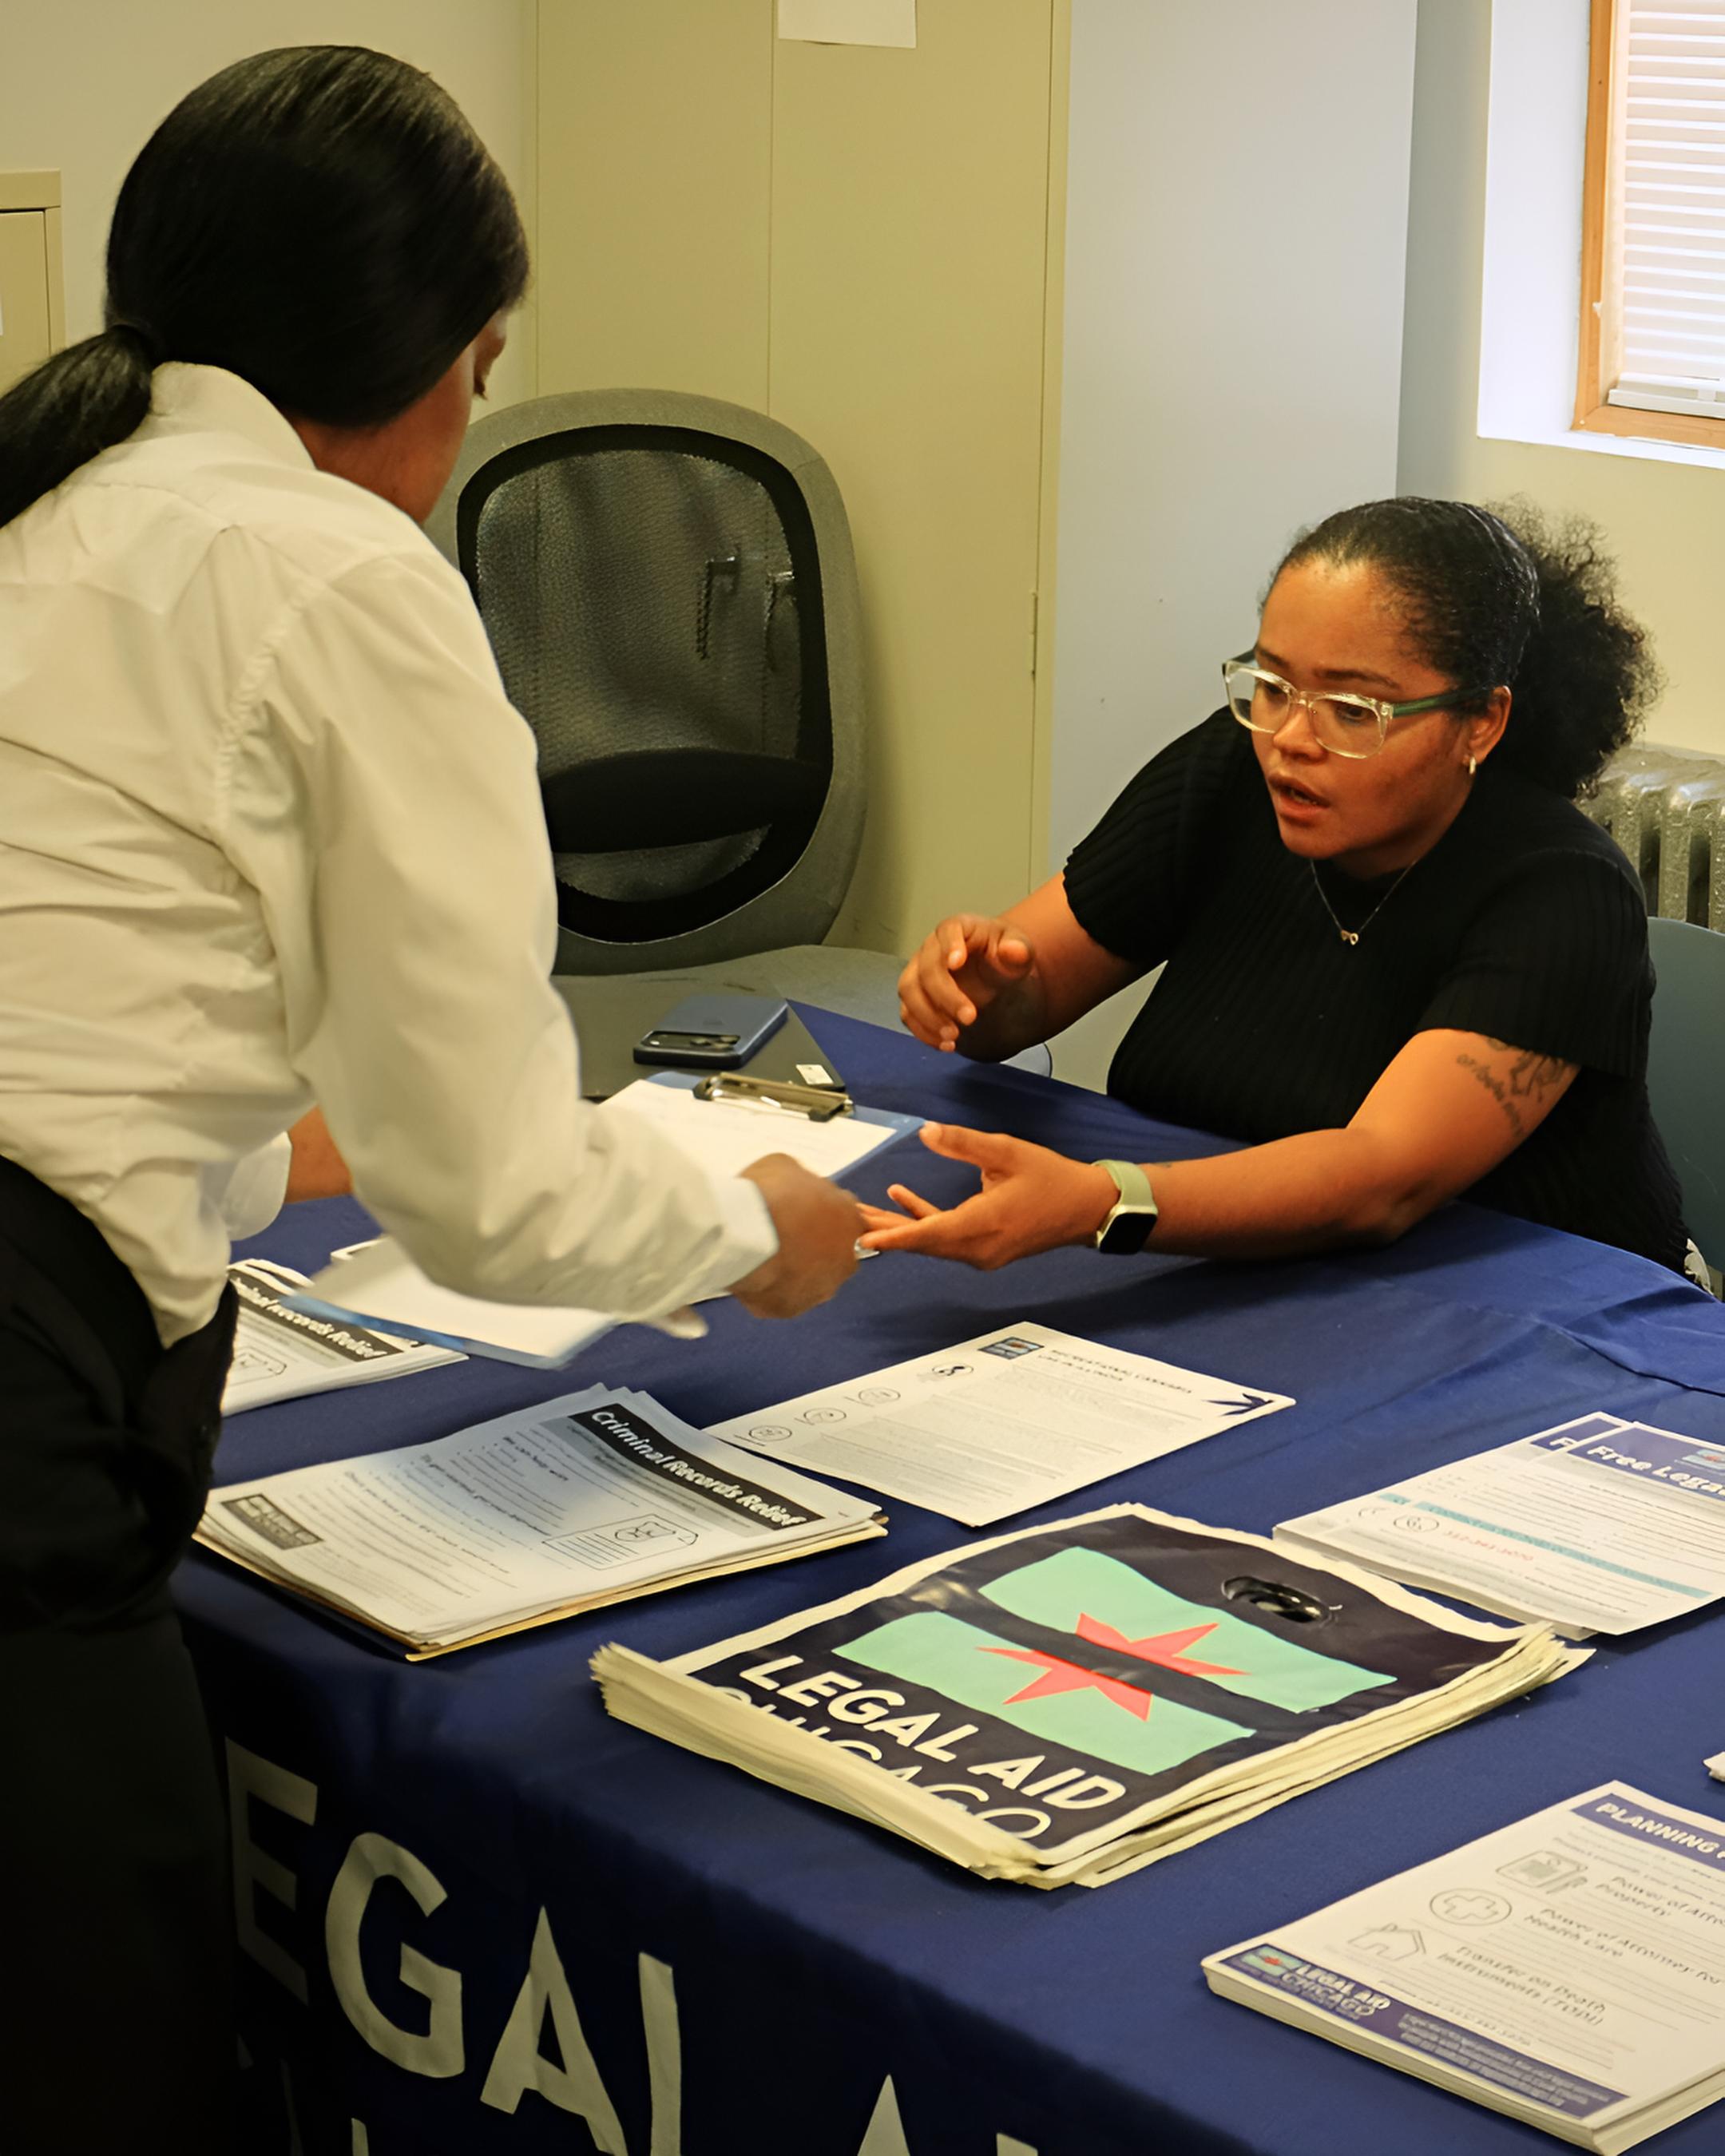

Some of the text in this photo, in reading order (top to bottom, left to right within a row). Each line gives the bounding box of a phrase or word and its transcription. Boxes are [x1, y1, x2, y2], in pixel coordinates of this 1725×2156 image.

[591, 1410, 676, 1466] Criminal
[1586, 1445, 1653, 1471] Free
[740, 1655, 980, 1763] LEGAL
[967, 1755, 1127, 1810] AID
[1595, 1801, 1720, 1853] PLANNING
